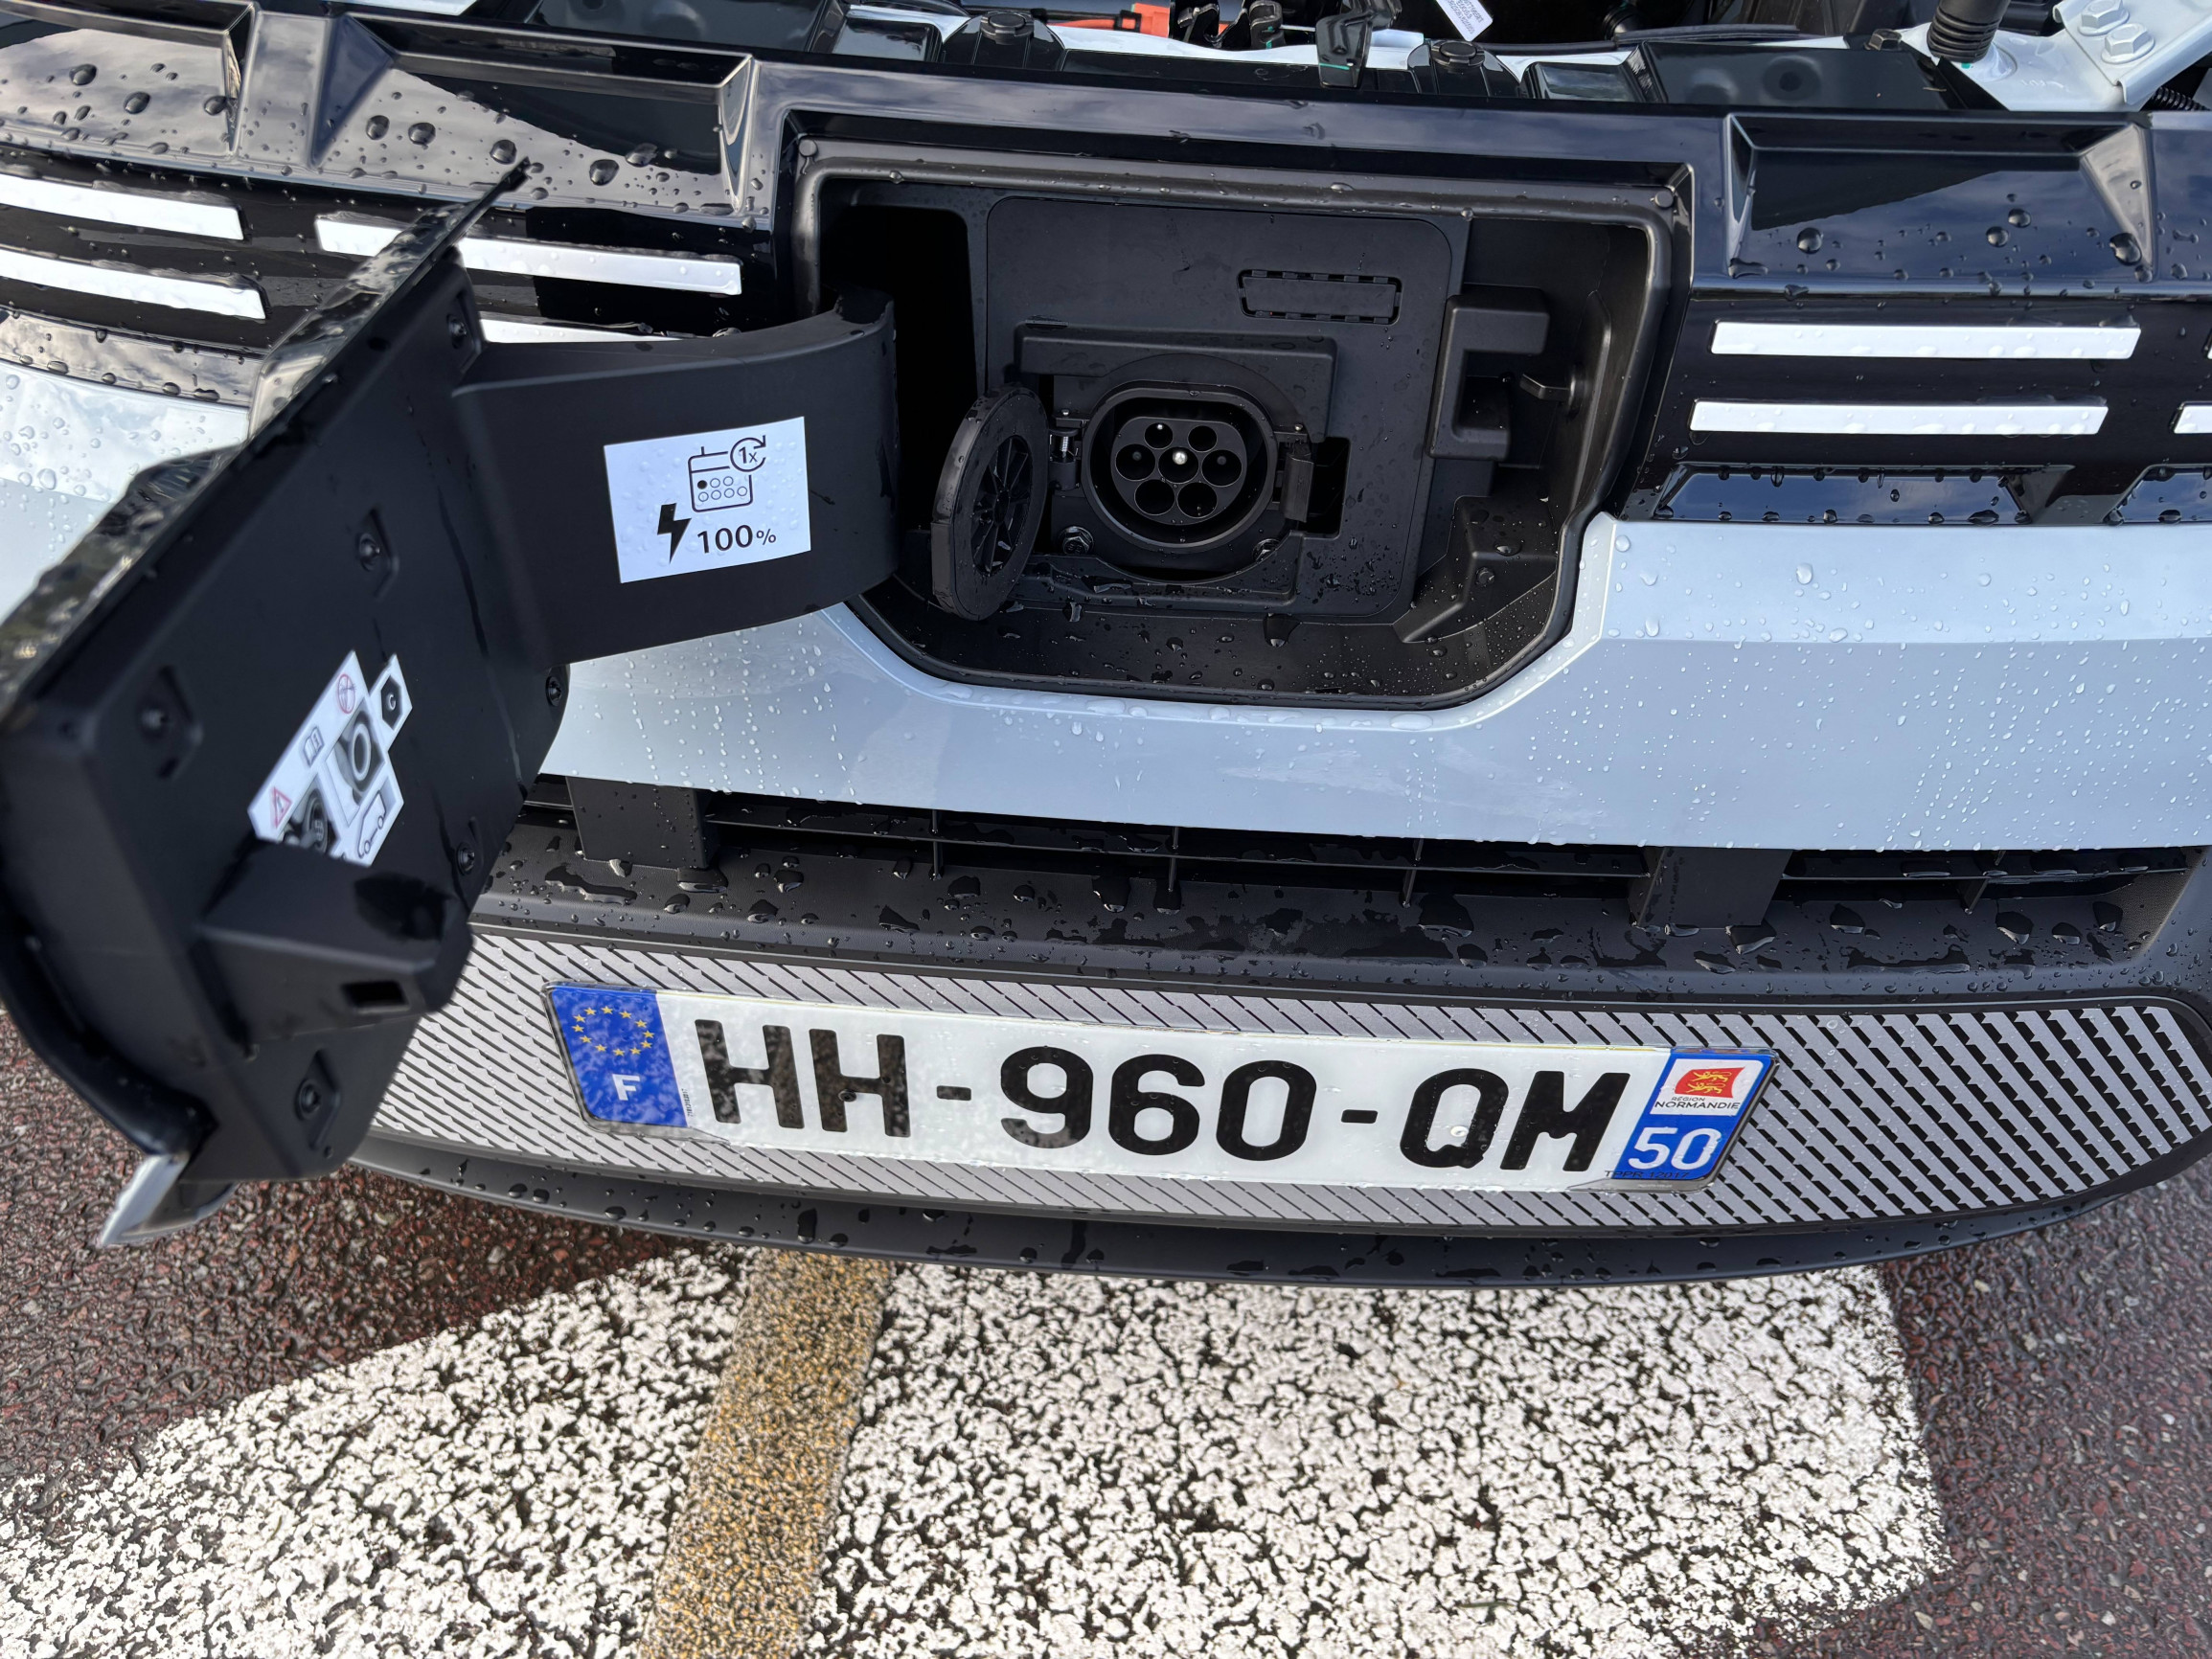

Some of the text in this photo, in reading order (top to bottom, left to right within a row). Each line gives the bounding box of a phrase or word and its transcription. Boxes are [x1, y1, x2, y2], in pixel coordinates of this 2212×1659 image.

[739, 446, 758, 464] 1x
[697, 524, 777, 554] 100%
[612, 1074, 641, 1102] F
[695, 1018, 1630, 1171] HH-960-QM
[1654, 1101, 1741, 1109] NORMANDIE
[1628, 1126, 1722, 1170] 50
